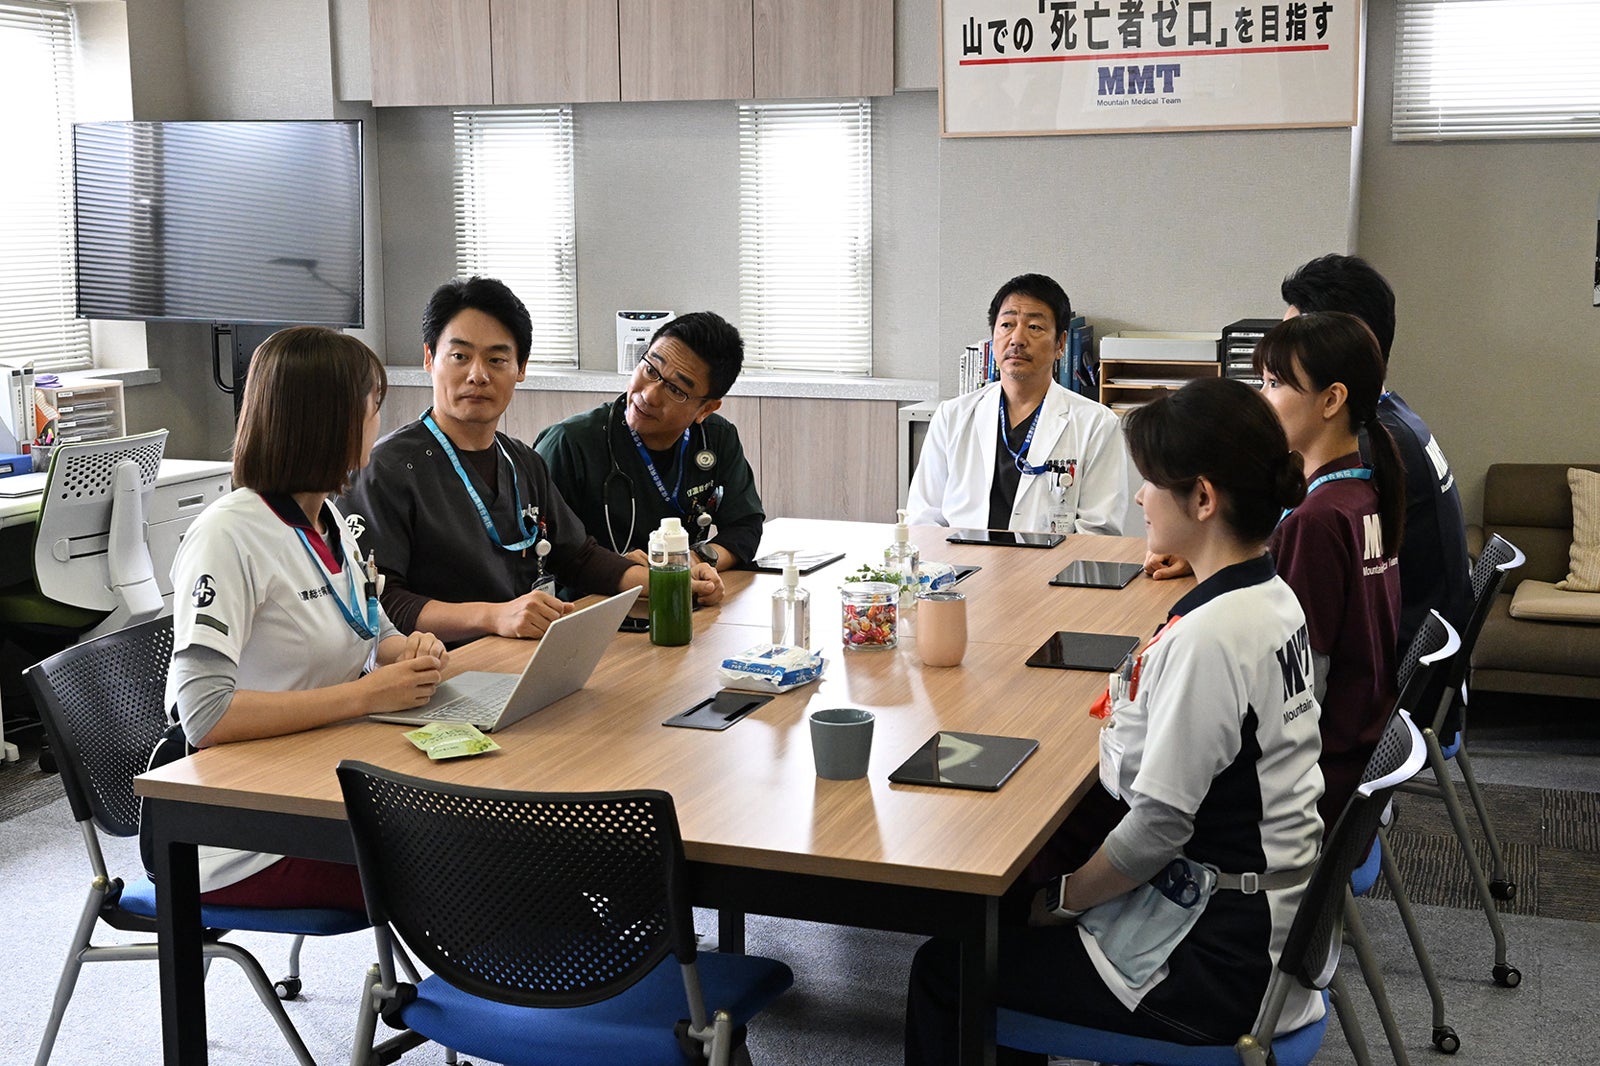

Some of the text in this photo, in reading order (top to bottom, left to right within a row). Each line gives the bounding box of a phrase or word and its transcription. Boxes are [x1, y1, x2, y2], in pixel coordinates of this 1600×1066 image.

[1097, 63, 1181, 96] MMT
[1096, 99, 1129, 107] Mountain
[1283, 699, 1314, 726] Mountain
